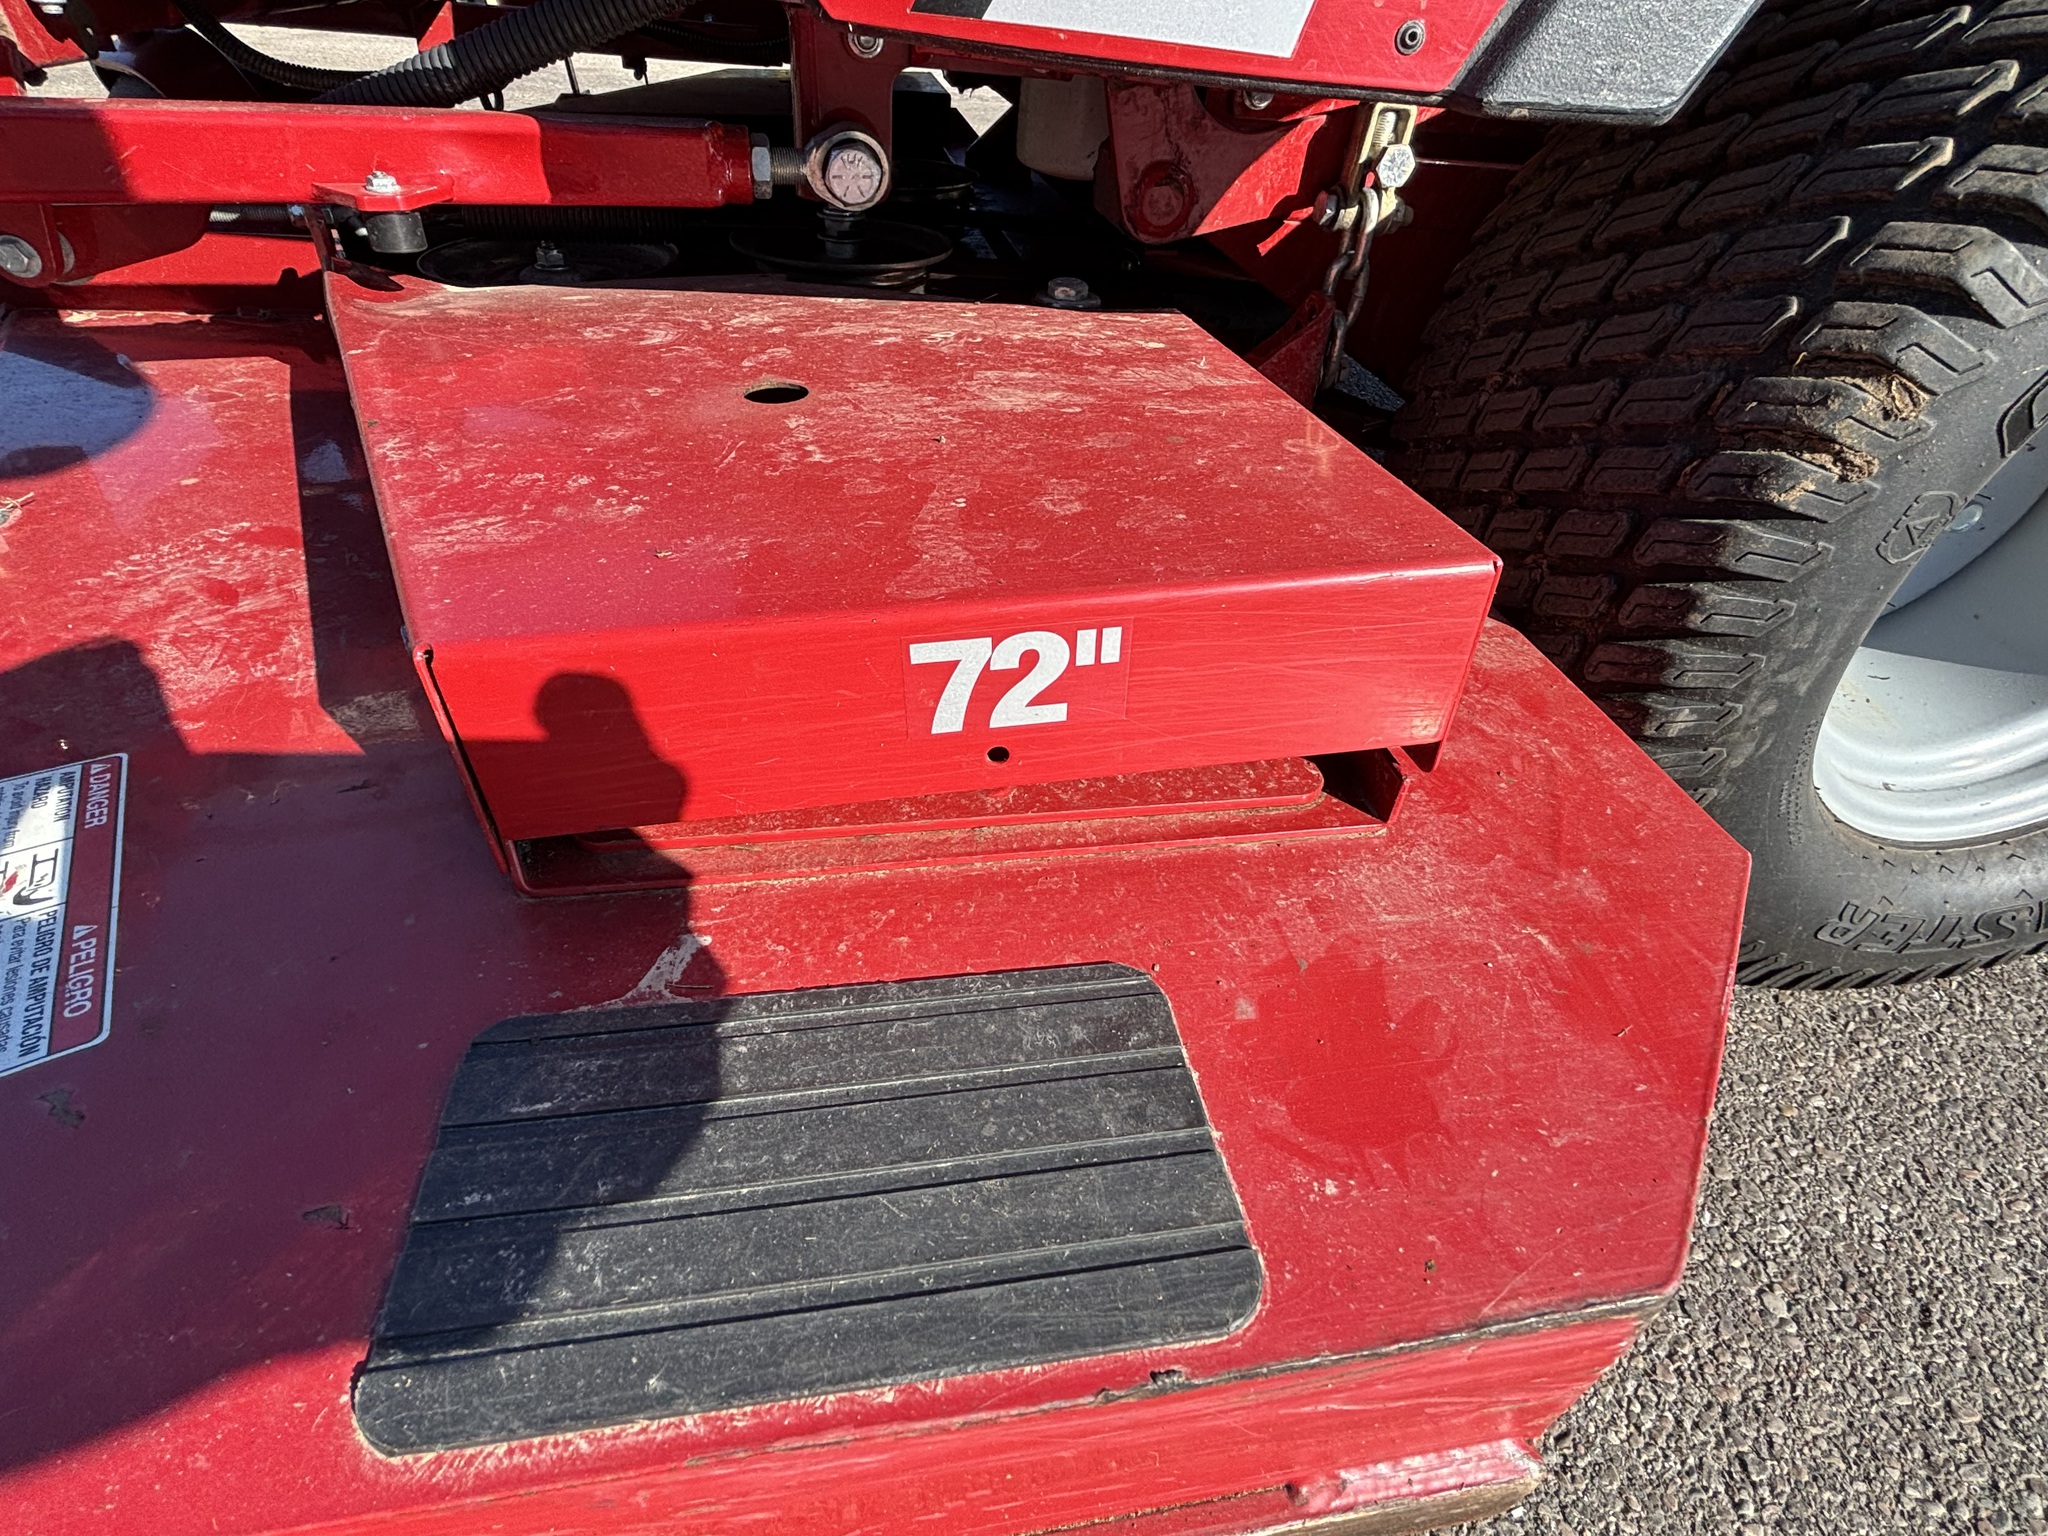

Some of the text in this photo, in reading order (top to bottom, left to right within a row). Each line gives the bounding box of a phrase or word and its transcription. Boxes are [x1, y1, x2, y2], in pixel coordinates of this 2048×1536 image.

[909, 626, 1122, 734] 72"
[30, 776, 52, 809] HAZARD
[53, 771, 76, 822] AMPUTATION
[84, 773, 111, 828] DANGER
[8, 939, 27, 964] evitar
[12, 917, 31, 939] Para
[0, 964, 24, 1006] lesiones
[18, 909, 57, 1057] PELIGRO DE AMPUTACIÓN
[63, 937, 97, 1017] PELIGRO
